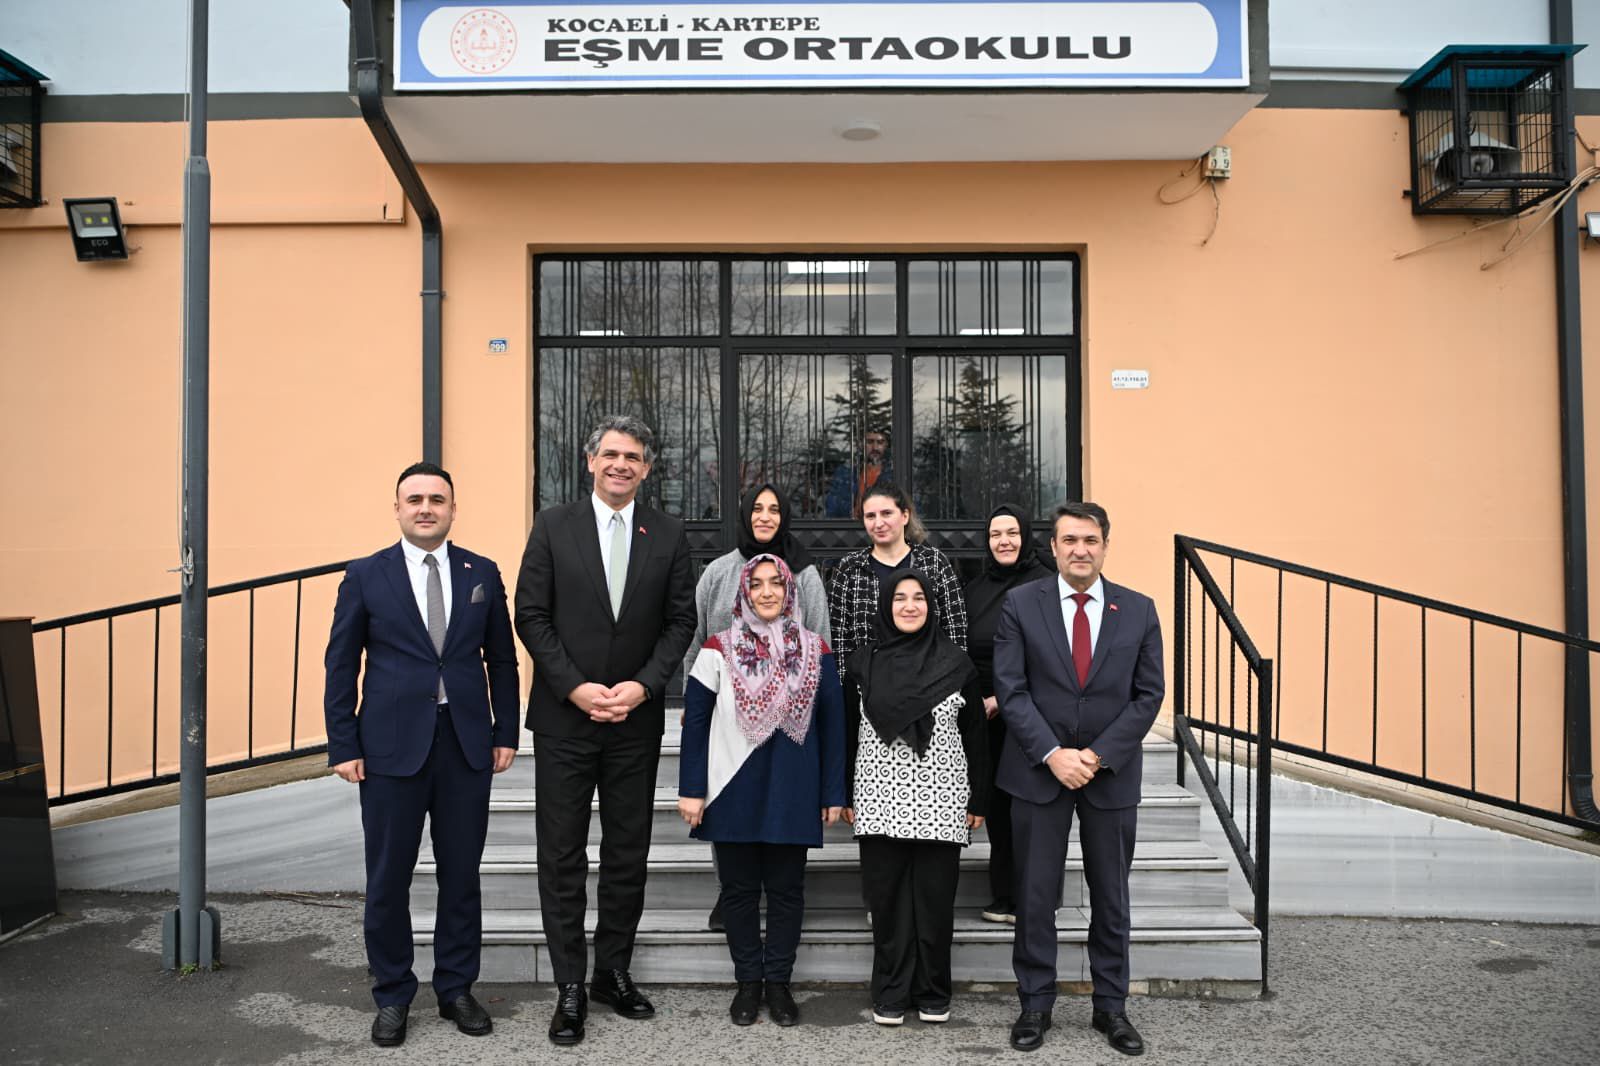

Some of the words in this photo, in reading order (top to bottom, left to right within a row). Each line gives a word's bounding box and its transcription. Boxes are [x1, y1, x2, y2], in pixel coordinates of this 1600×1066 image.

[547, 14, 669, 33] KOCAELİ
[692, 17, 820, 32] KARTEPE
[544, 38, 723, 69] EŞME
[743, 36, 1132, 61] ORTAOKULU
